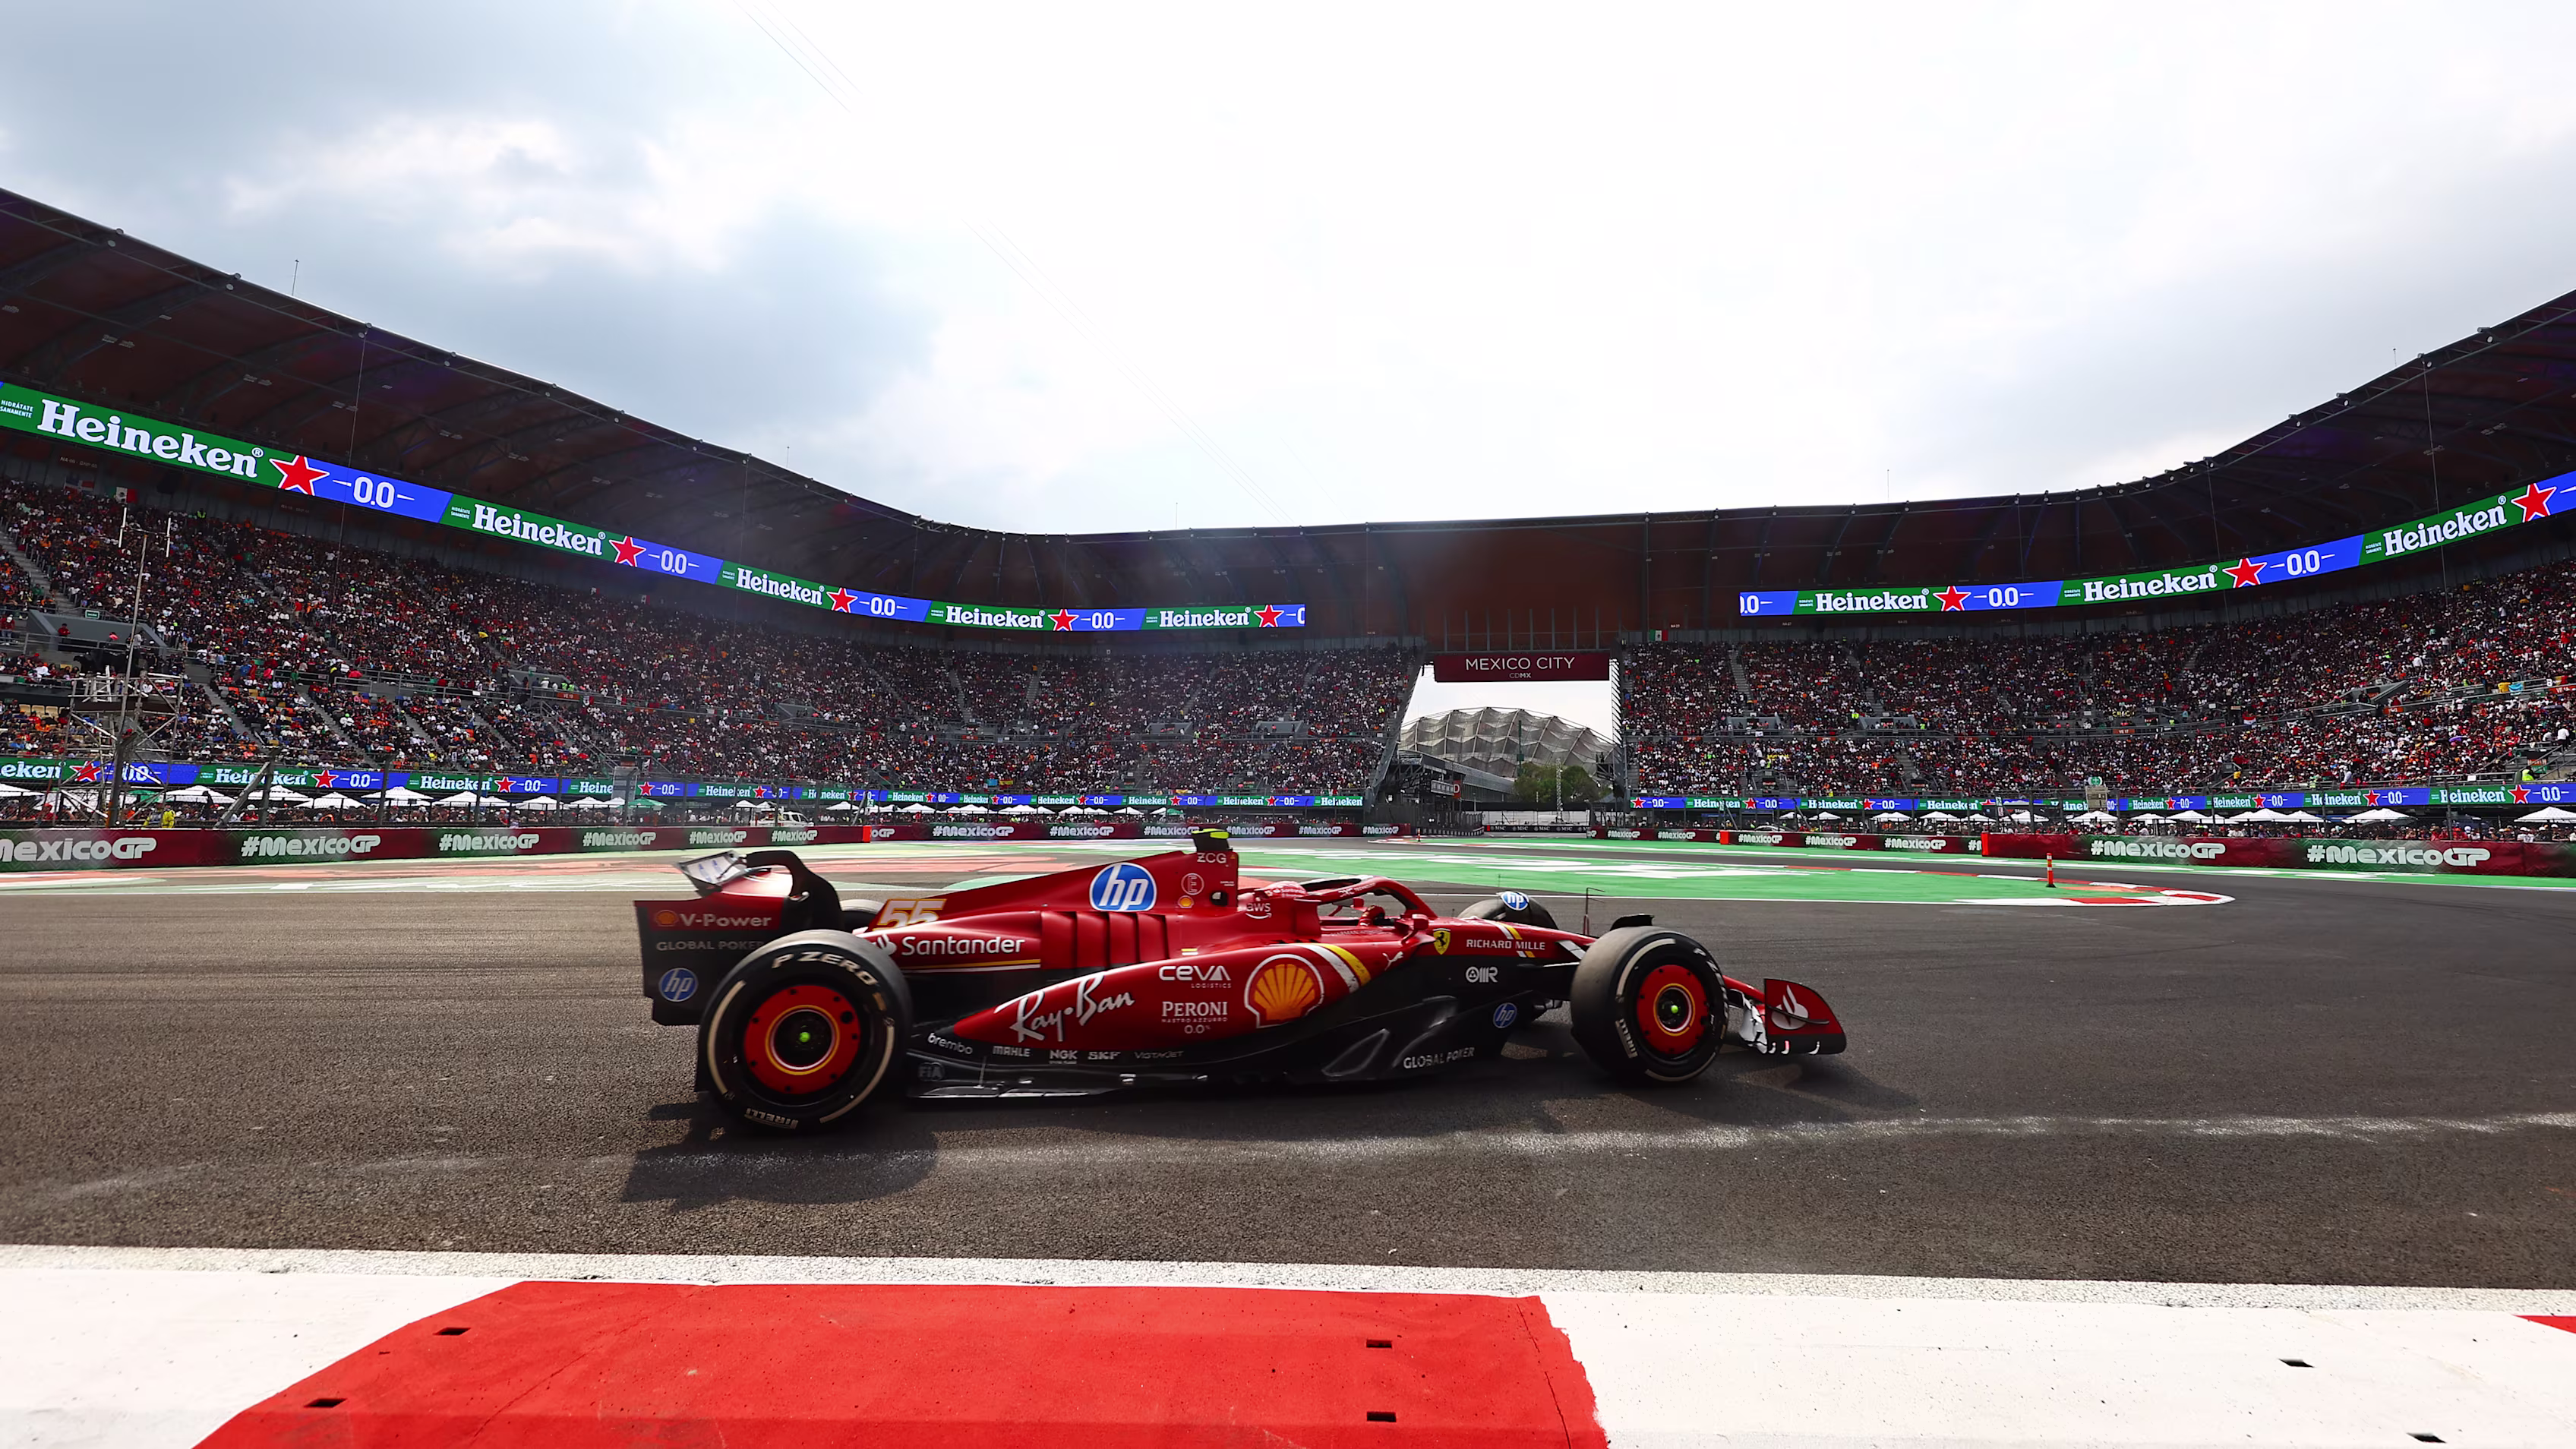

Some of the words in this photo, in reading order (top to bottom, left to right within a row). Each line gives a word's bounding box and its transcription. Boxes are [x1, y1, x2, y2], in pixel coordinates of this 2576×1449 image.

[0, 406, 32, 418] SANAMENTE
[1, 399, 33, 412] HIDRÁTATE
[1466, 657, 1531, 671] MEXICO
[1536, 656, 1576, 669] CITY
[0, 761, 61, 778] eken
[579, 781, 614, 794] Heine
[690, 830, 747, 844] #MexicoGP
[772, 829, 818, 842] #MexicoGP
[932, 826, 1015, 838] #MexicoGP
[1050, 826, 1114, 837] #MexicoGP
[1299, 826, 1342, 835] #MexicoGP
[1362, 826, 1399, 835] #MexicoGP
[1658, 831, 1696, 840] #MexicoGP
[439, 833, 539, 851] #MexicoGP
[583, 832, 656, 847] #MexicoGP
[1738, 834, 1783, 844] #MexicoGP
[1805, 836, 1857, 847] #MexicoGP
[1884, 838, 1946, 850] #MexicoGP
[241, 835, 380, 857] #MexicoGP
[2091, 840, 2226, 860] #MexicoGP
[1197, 852, 1227, 863] ZCG
[2306, 844, 2491, 867] #MexicoGP
[1099, 864, 1150, 911] hp
[1245, 902, 1271, 912] aws
[1504, 892, 1526, 910] hp
[680, 913, 772, 927] V-Power
[873, 898, 947, 931] 55
[656, 941, 714, 951] GLOBAL
[901, 936, 1025, 956] Santander
[1466, 939, 1512, 949] RICHARD
[1515, 940, 1546, 950] MILLE
[772, 953, 794, 969] P
[797, 951, 879, 986] ZERO
[664, 969, 693, 1000] hp
[1161, 1001, 1228, 1017] PERONI
[1495, 1003, 1516, 1028] hp
[927, 1033, 973, 1055] brembo
[993, 1045, 1031, 1057] MAHLE
[1050, 1049, 1078, 1060] NGK
[1088, 1051, 1121, 1060] SKF
[1403, 1052, 1445, 1069] GLOBAL
